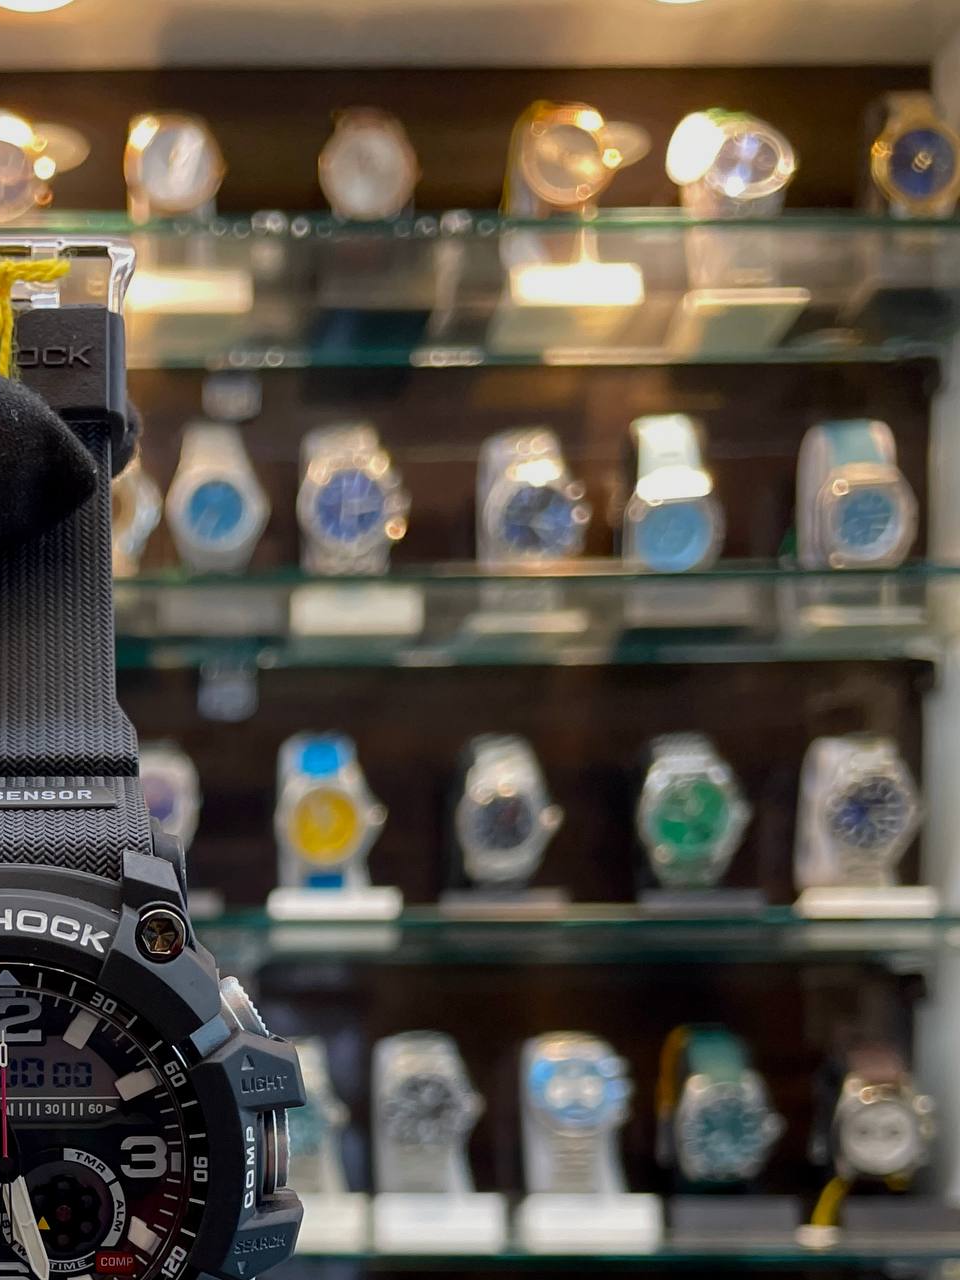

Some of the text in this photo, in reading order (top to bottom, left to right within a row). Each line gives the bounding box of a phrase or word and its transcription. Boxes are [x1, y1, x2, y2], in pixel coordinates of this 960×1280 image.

[89, 991, 118, 1015] 30
[163, 1062, 188, 1088] 60
[241, 1074, 288, 1094] LIGHT
[44, 1103, 59, 1114] 30
[88, 1103, 103, 1114] 60
[74, 1151, 105, 1173] TMR
[120, 1135, 168, 1179] 3
[244, 1125, 257, 1209] COMP
[113, 1199, 125, 1233] ALM
[234, 1235, 287, 1256] SEARCH
[49, 1259, 87, 1271] TIME
[100, 1256, 134, 1267] COMP
[161, 1245, 188, 1279] 120
